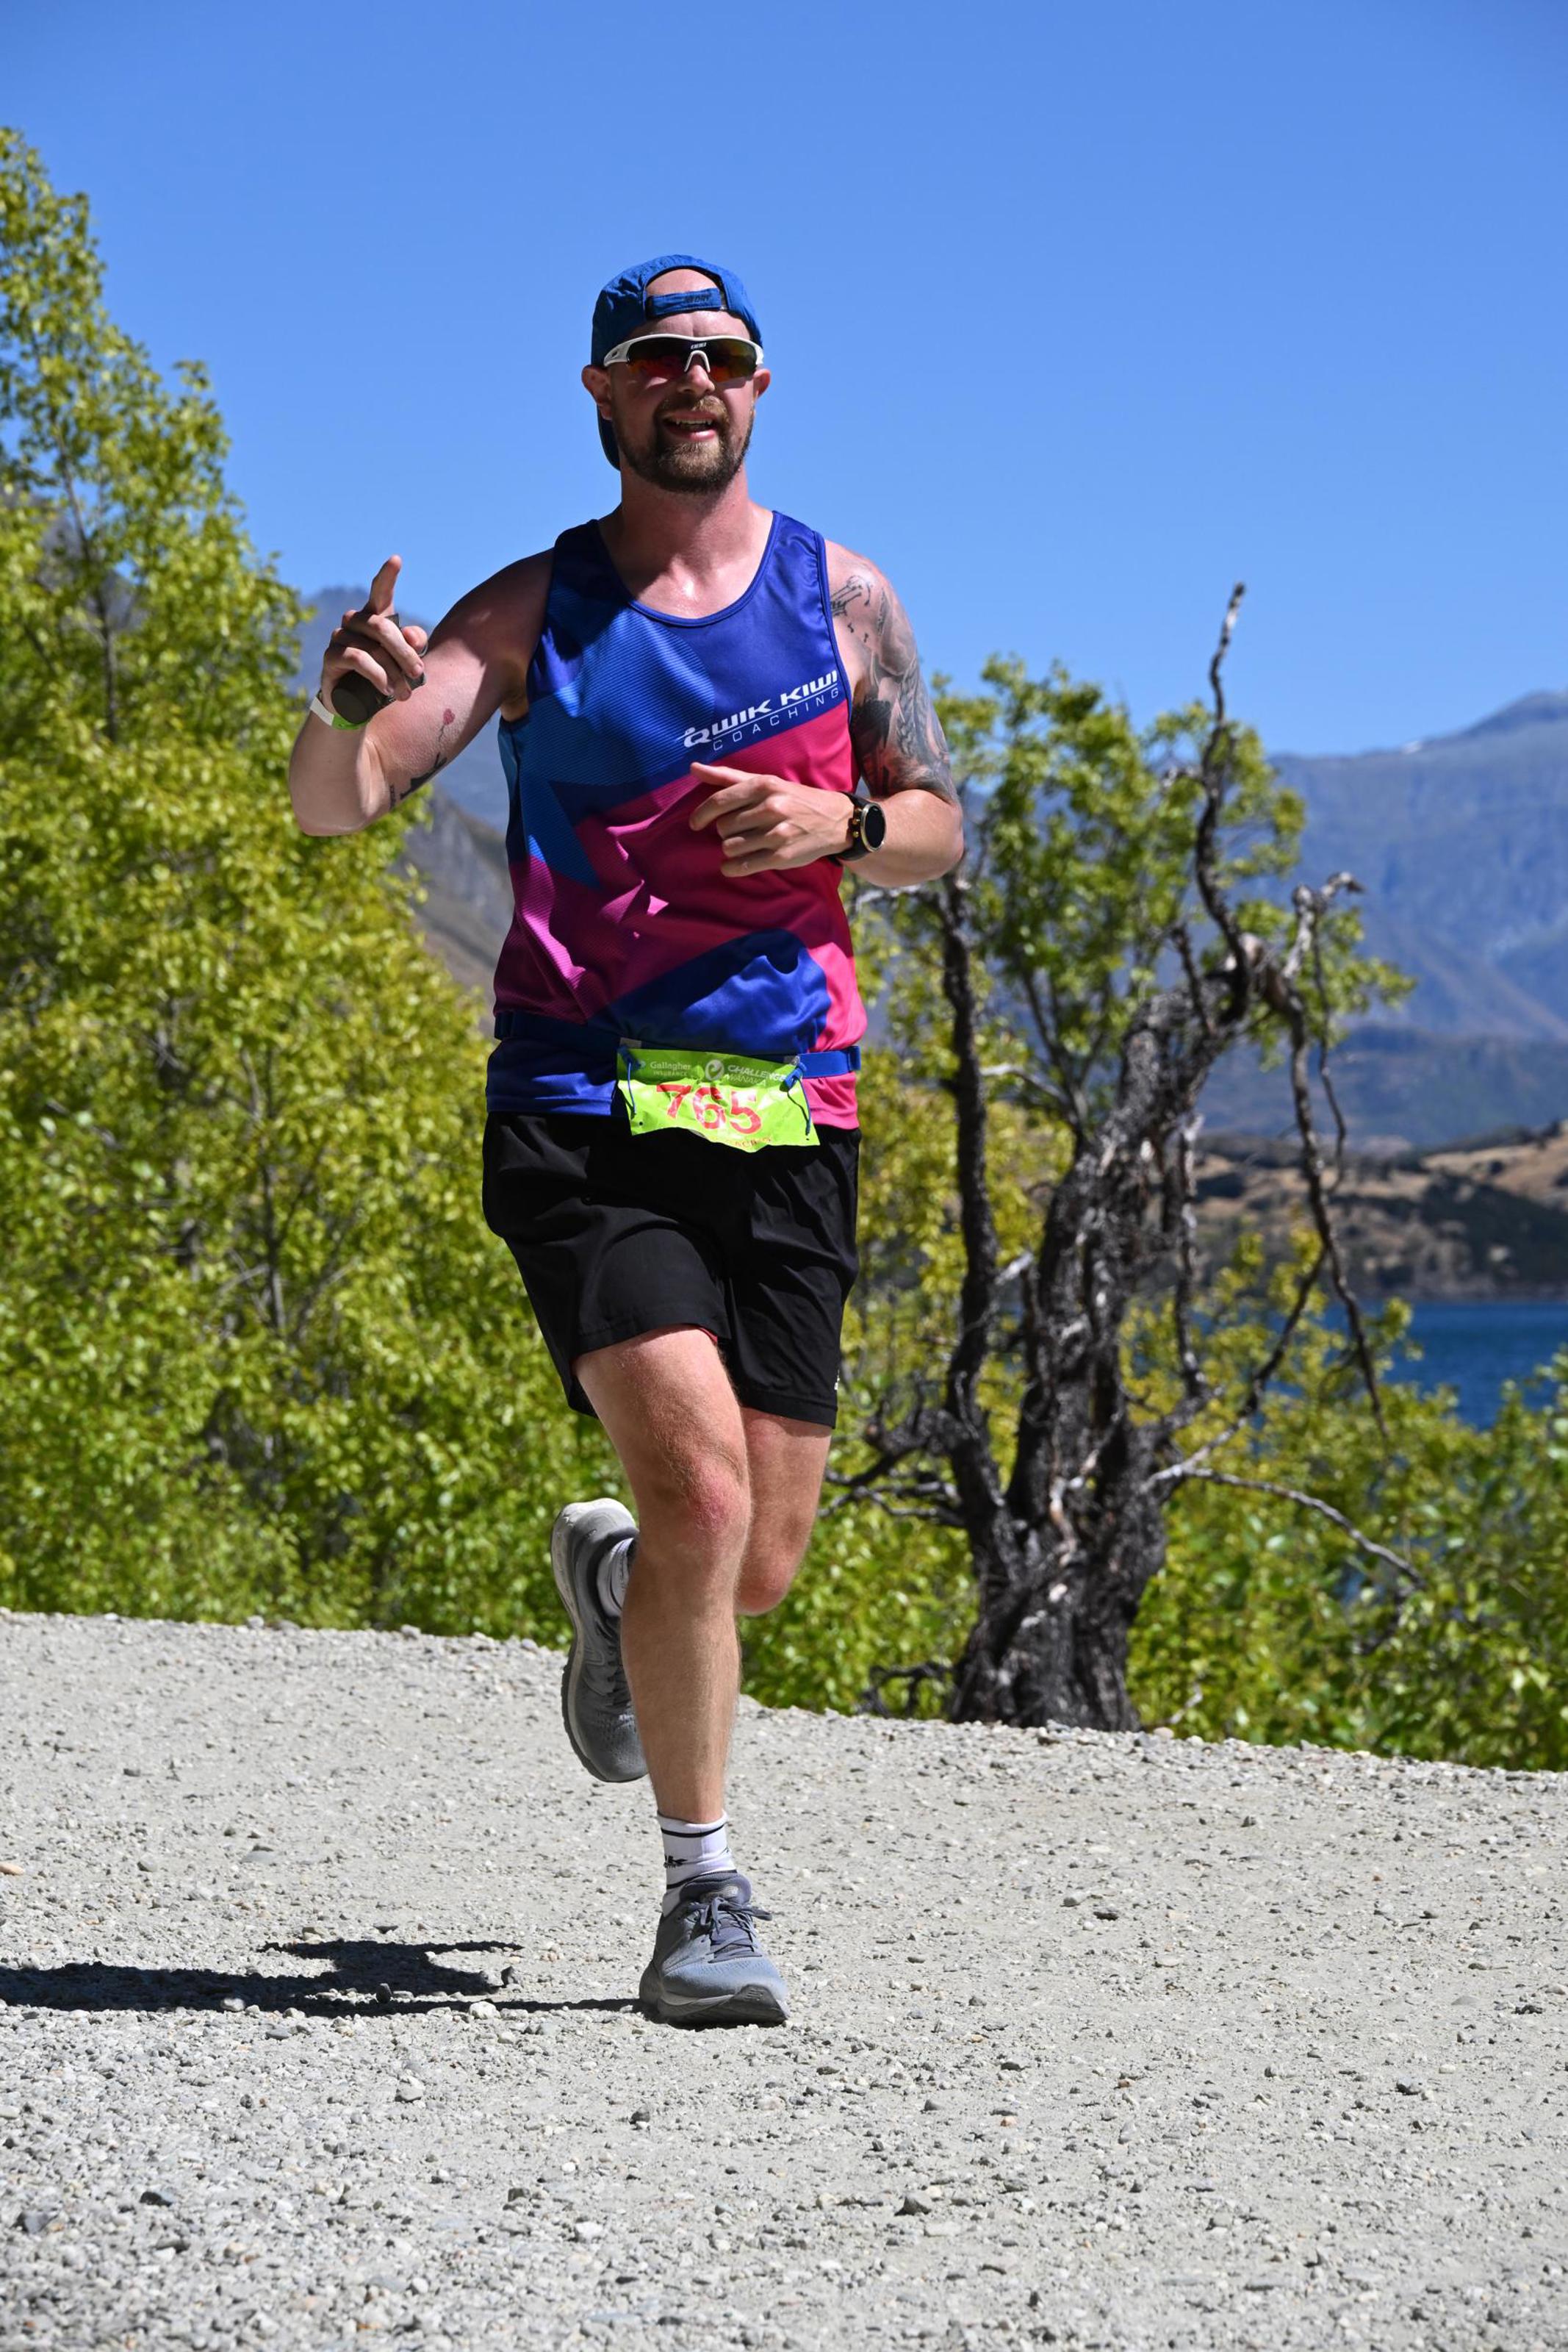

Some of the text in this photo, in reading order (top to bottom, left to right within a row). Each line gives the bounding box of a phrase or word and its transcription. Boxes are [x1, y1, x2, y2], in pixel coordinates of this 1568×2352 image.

[683, 670, 838, 748] QWIK KIWI
[713, 687, 839, 751] COACHING
[650, 1061, 692, 1072] Gallagher
[727, 1064, 786, 1083] CHALLENGE
[656, 1083, 762, 1135] 765
